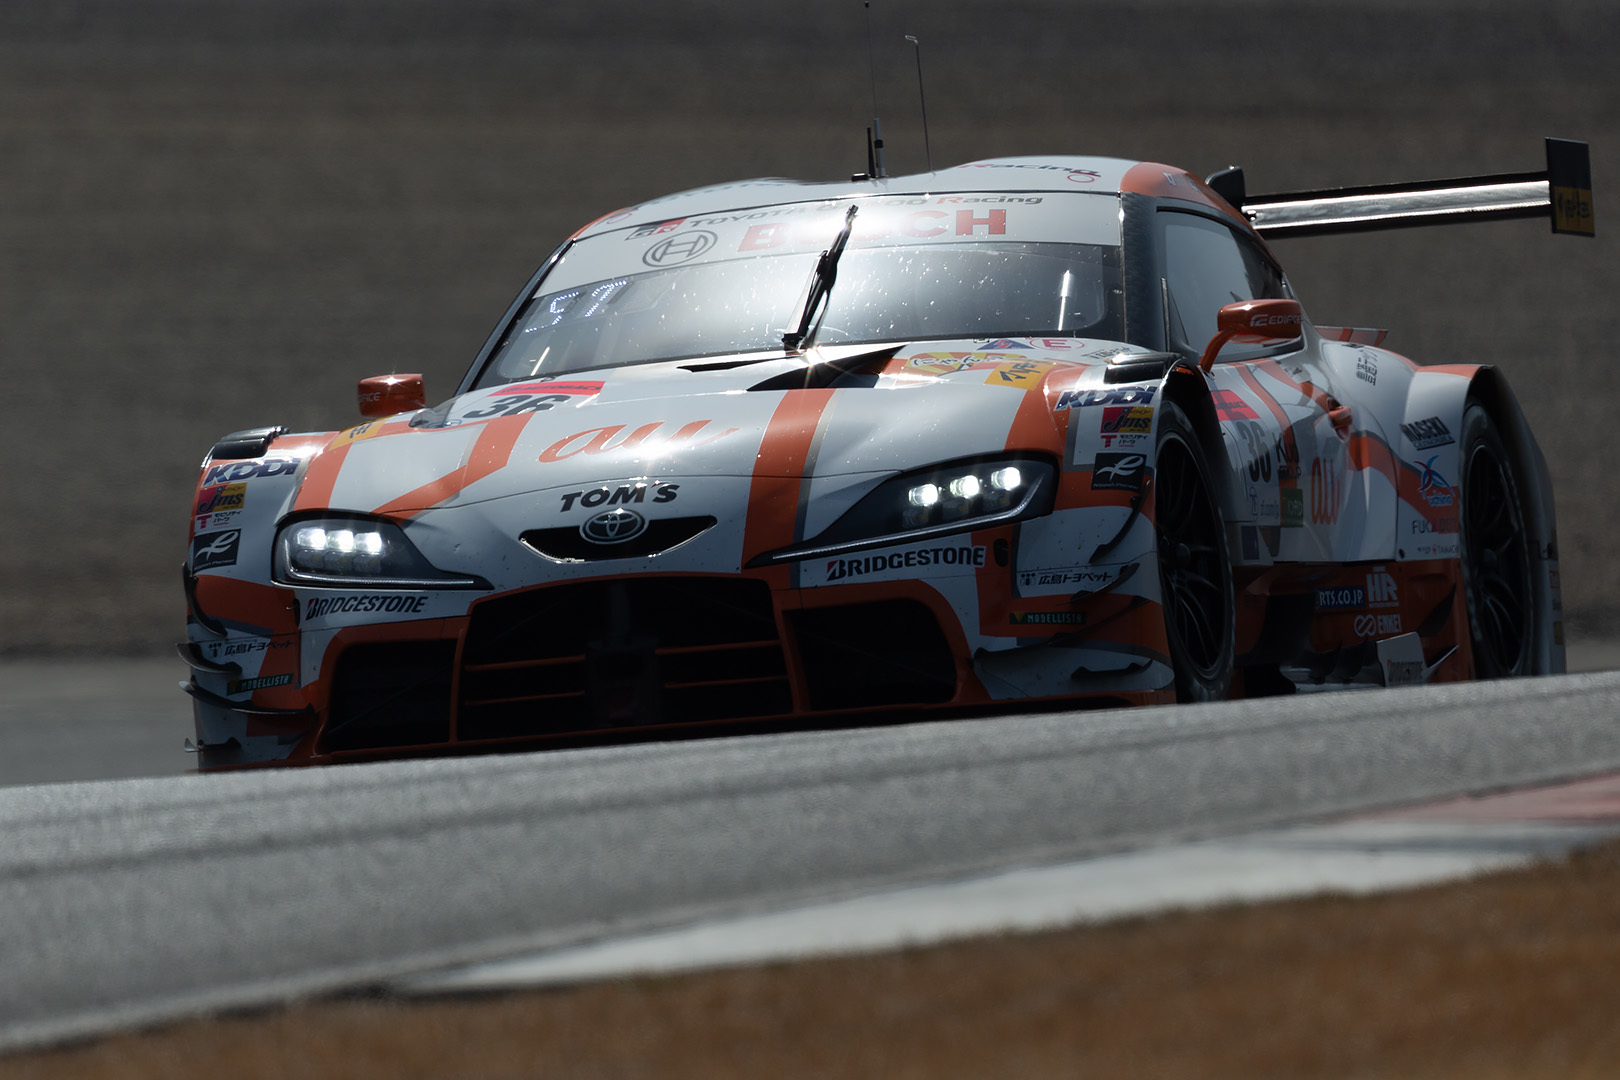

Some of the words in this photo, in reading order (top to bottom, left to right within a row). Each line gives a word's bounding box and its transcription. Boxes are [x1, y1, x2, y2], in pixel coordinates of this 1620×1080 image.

[936, 195, 1044, 205] Racing
[738, 209, 1006, 251] BCH
[463, 394, 571, 418] 36
[1054, 386, 1157, 411] KDDI
[1103, 407, 1151, 433] jms
[1235, 421, 1272, 484] 36
[203, 459, 300, 487] KDDI
[198, 486, 244, 513] jms
[561, 481, 680, 513] TOM'S
[827, 547, 985, 581] BRIDGESTONE
[306, 596, 428, 621] BRIDGESTONE
